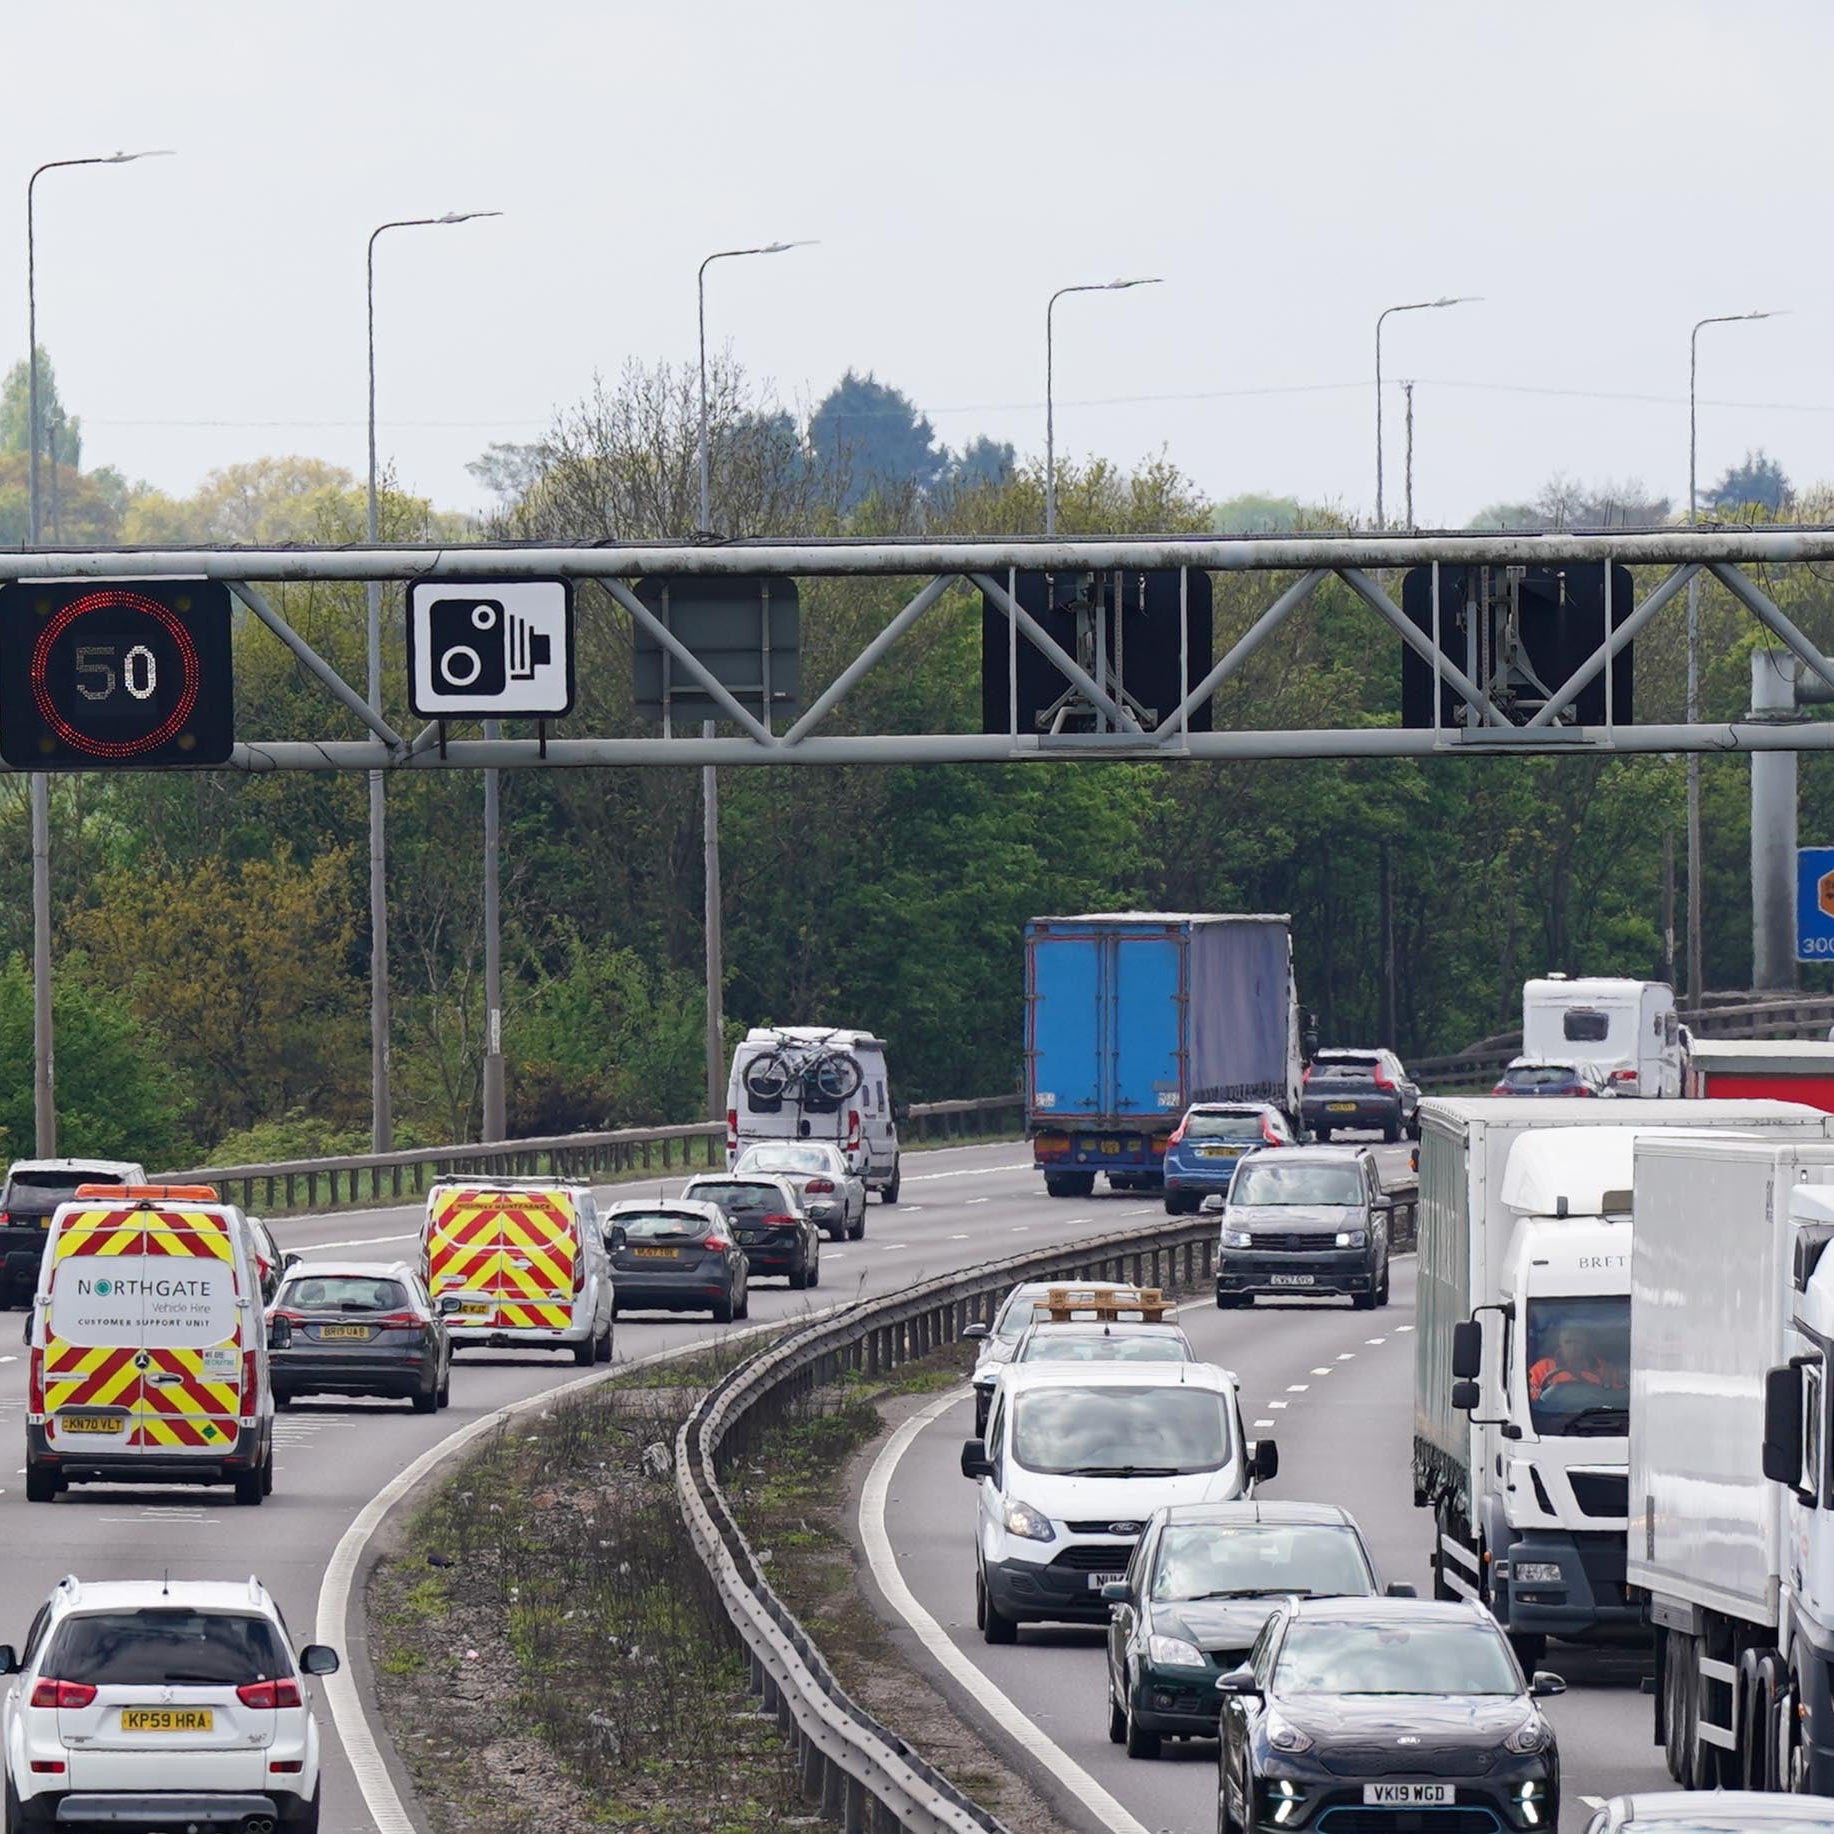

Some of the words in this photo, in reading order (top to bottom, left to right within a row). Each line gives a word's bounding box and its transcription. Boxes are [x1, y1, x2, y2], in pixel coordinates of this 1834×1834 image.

[76, 645, 156, 700] 50
[1579, 1255, 1631, 1269] BRET
[78, 1279, 211, 1297] NORTHGATE
[153, 1302, 188, 1314] Vehicle
[190, 1302, 211, 1313] Hire
[78, 1318, 132, 1327] CUSTOMER
[136, 1318, 181, 1327] SUPPORT
[185, 1318, 210, 1327] UNIT
[69, 1416, 98, 1430] KN70
[101, 1417, 122, 1430] VLT
[128, 1715, 171, 1728] KP59
[175, 1715, 206, 1729] HRA
[1374, 1786, 1409, 1801] VK19
[1414, 1786, 1445, 1801] WGD
